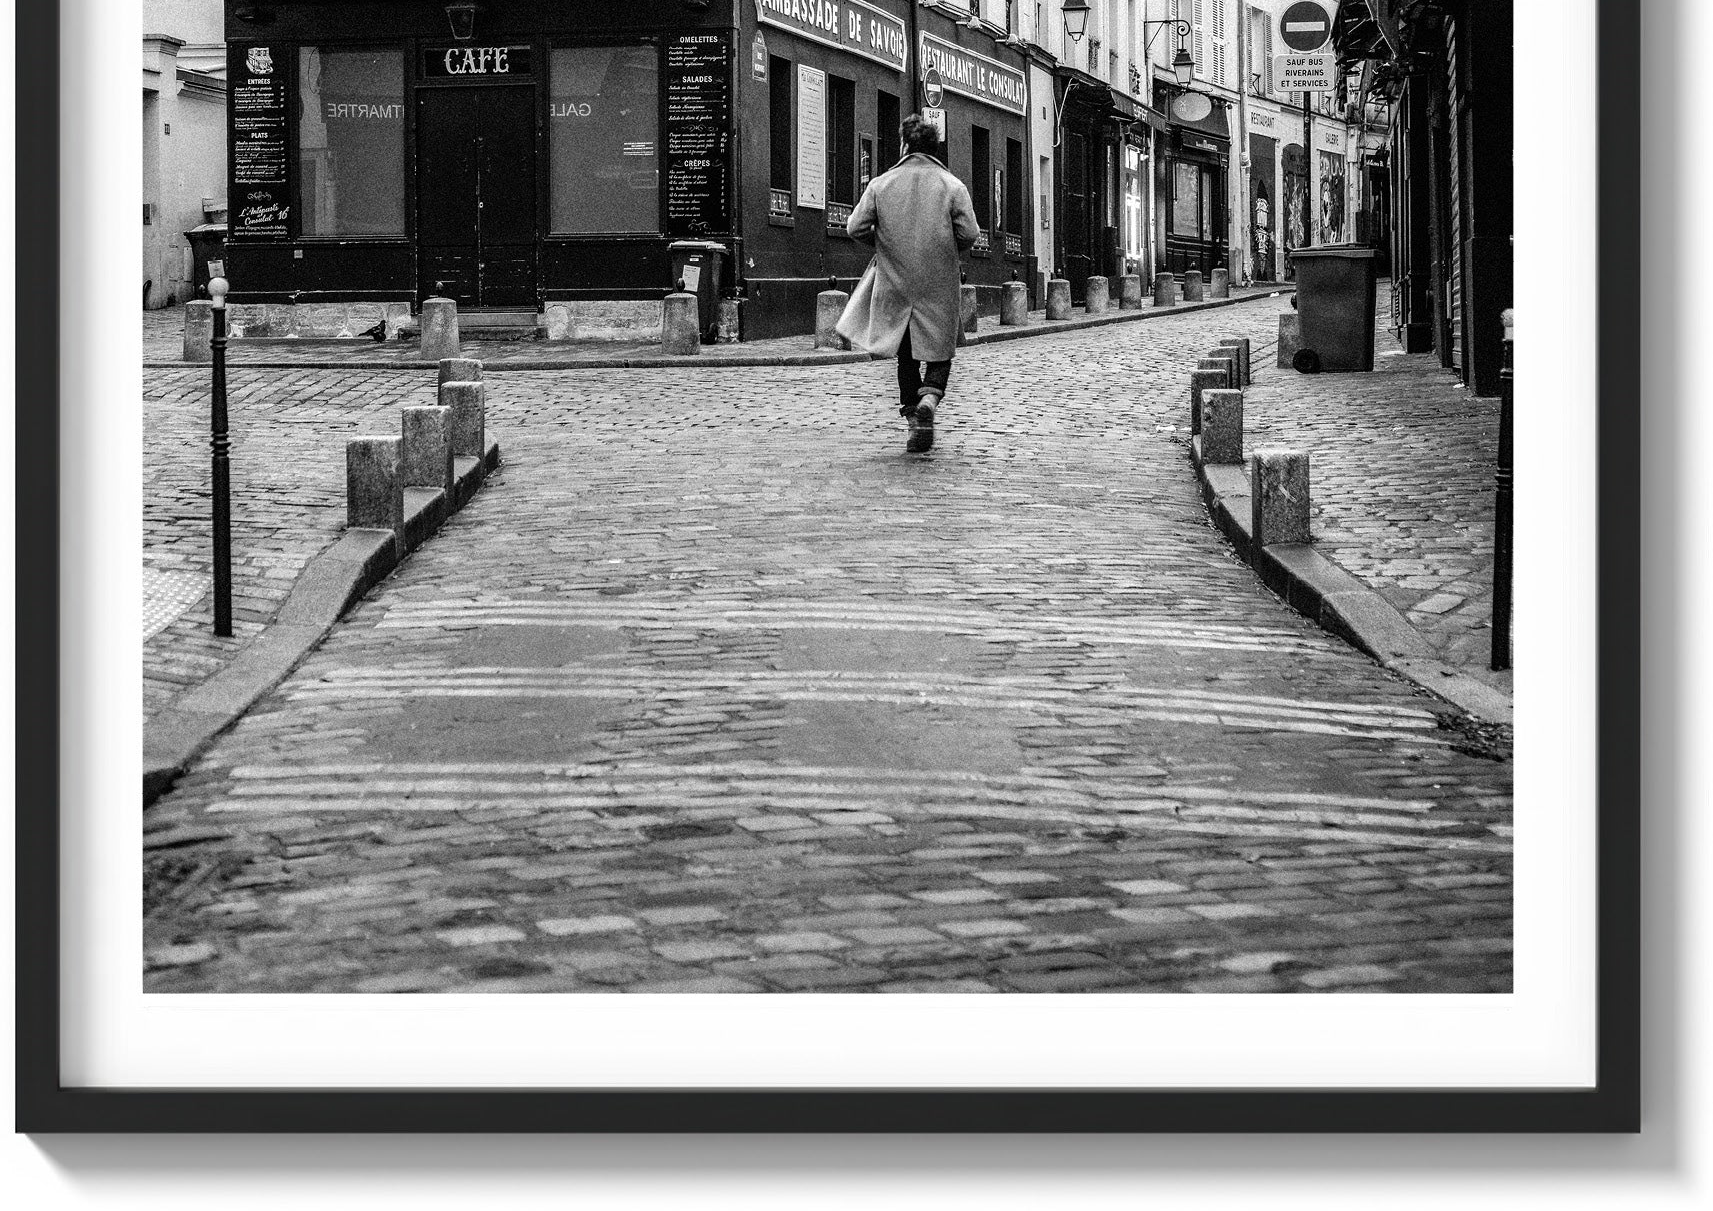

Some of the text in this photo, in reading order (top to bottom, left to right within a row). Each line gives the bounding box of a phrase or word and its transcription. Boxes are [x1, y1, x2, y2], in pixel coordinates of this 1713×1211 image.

[849, 9, 862, 43] DE
[870, 19, 903, 60] SAVOIE
[679, 35, 718, 43] OMELETTES
[1286, 58, 1323, 66] SAUF BUS
[921, 44, 1023, 105] RESTAURANT LE CONSULAT
[1285, 69, 1324, 77] RIVERAINS
[682, 75, 713, 83] SALADES
[1293, 79, 1328, 87] SERVICES
[683, 159, 711, 167] CRÊPES
